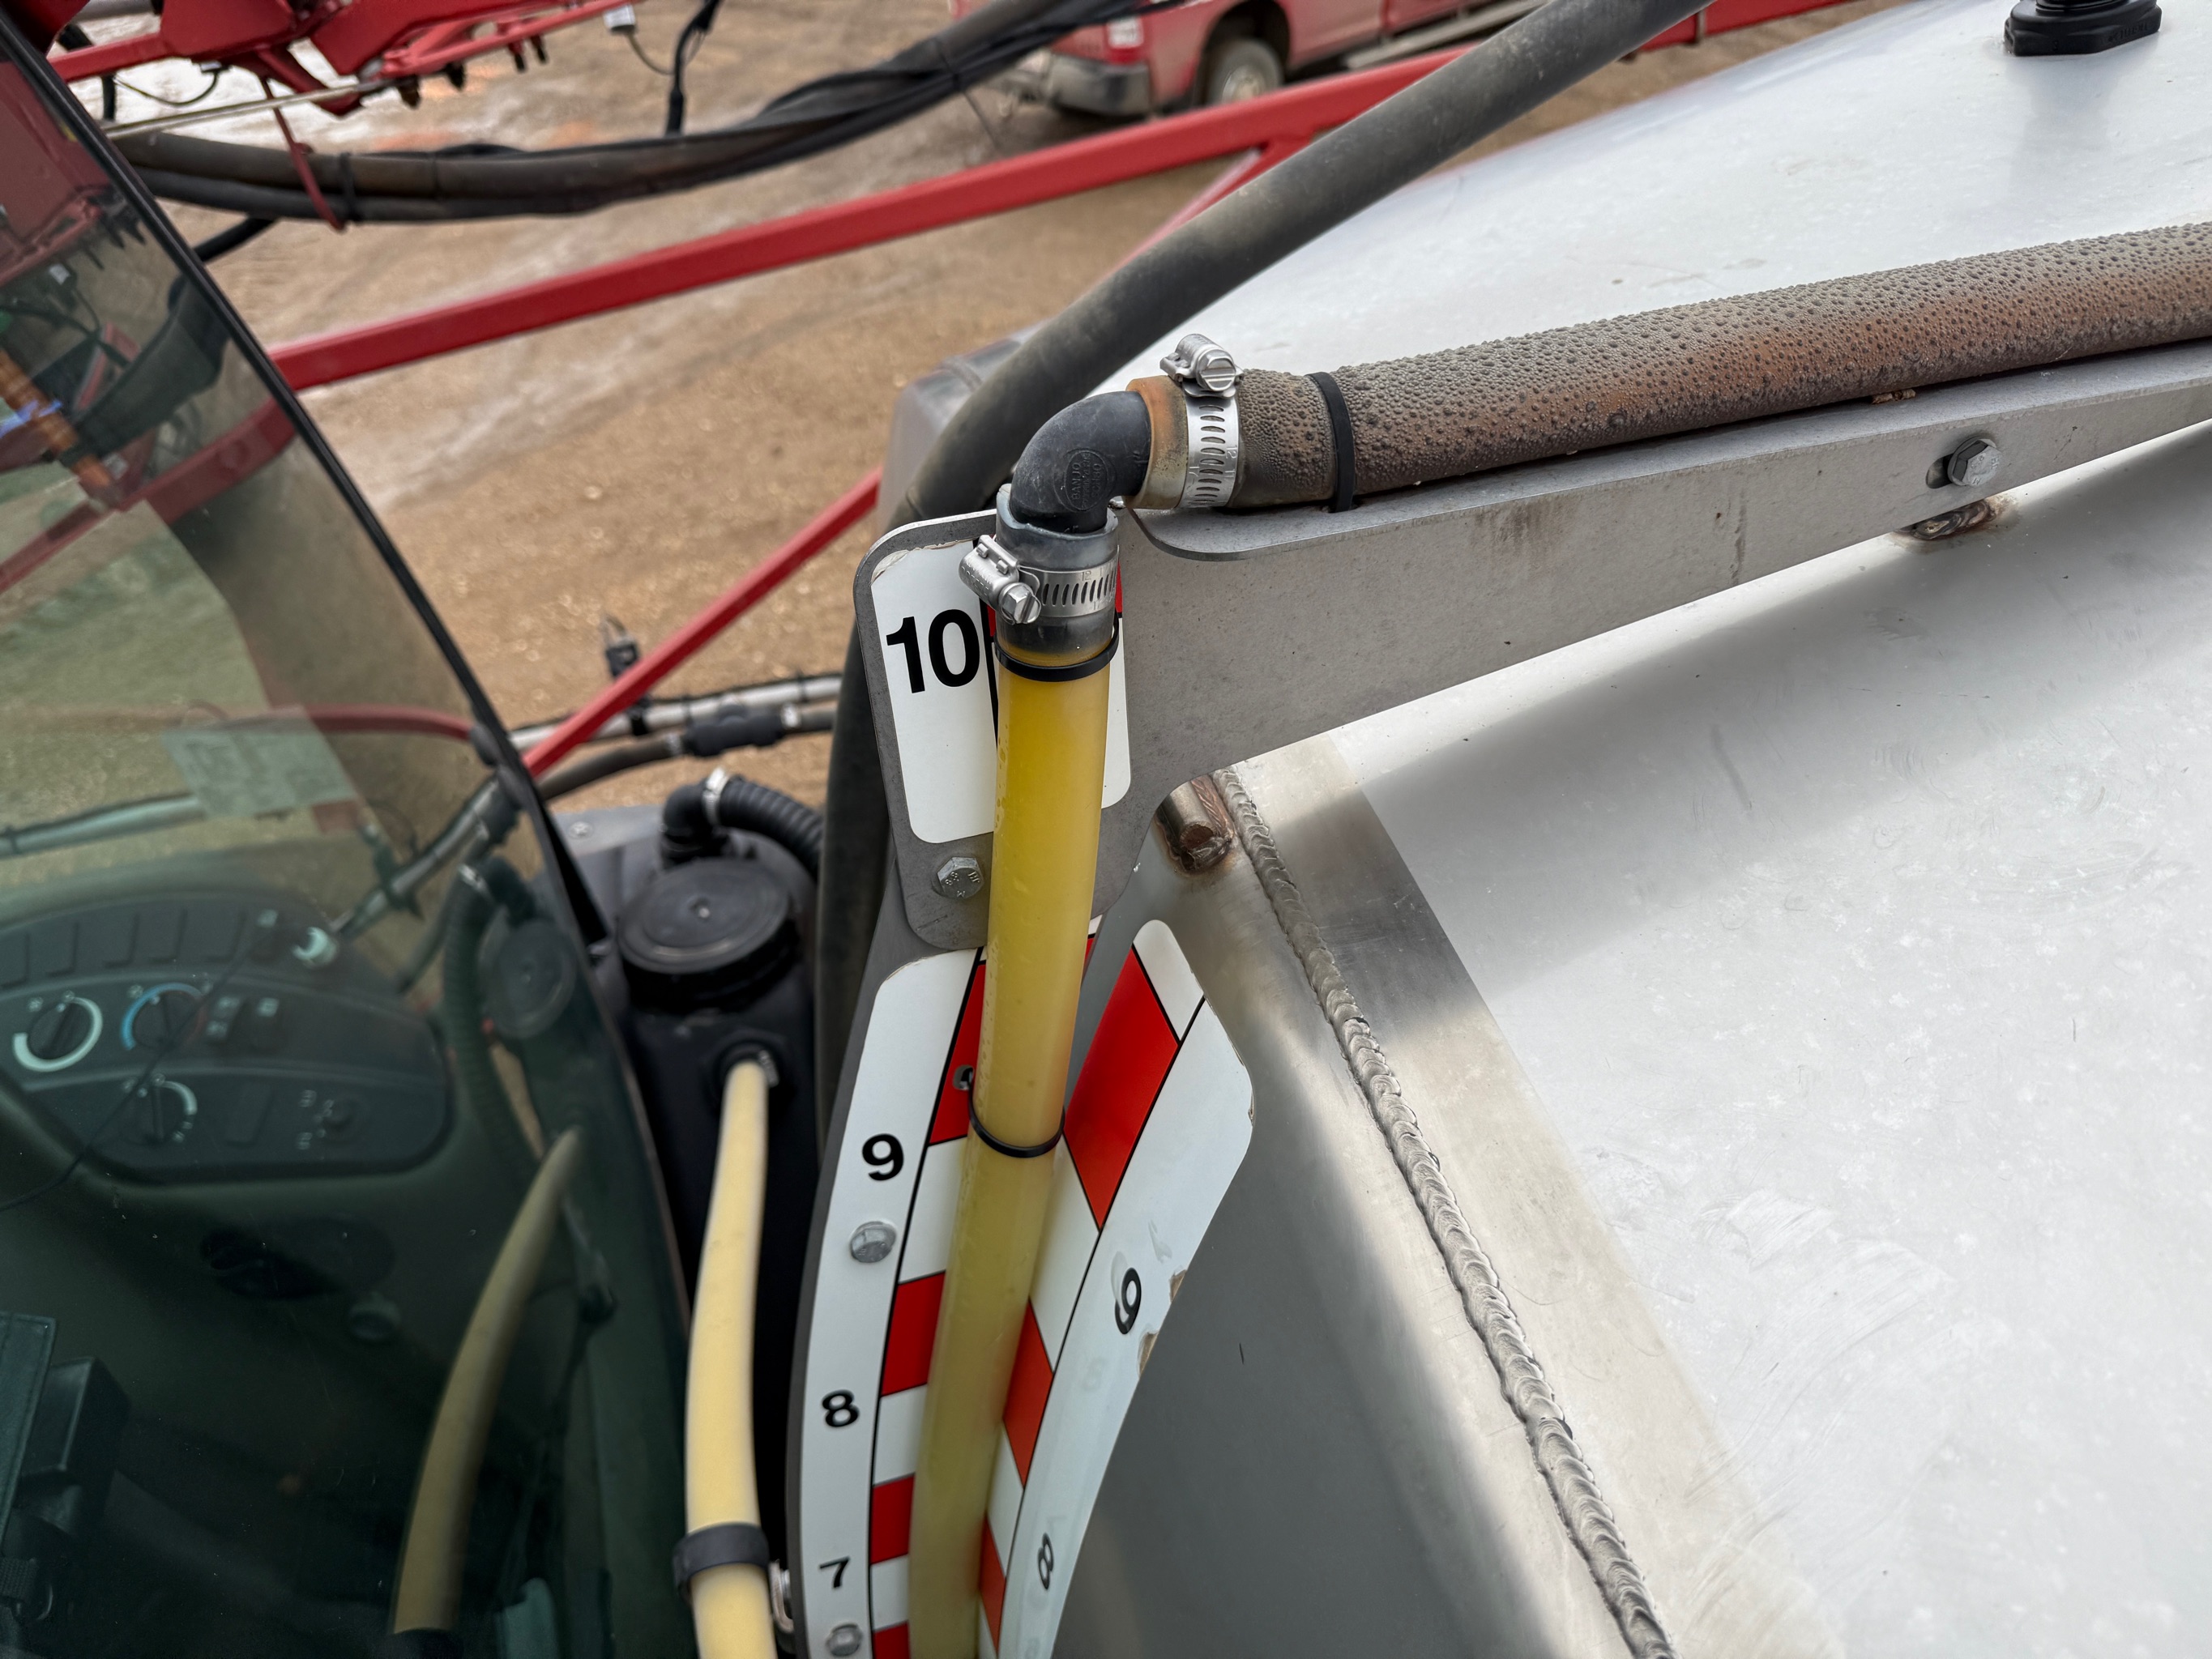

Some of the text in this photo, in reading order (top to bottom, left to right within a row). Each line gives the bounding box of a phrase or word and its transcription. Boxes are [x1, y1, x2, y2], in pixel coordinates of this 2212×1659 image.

[1071, 463, 1082, 500] BANJO
[886, 608, 980, 694] 10
[860, 1133, 905, 1181] 9
[821, 1389, 860, 1428] 8
[818, 1556, 853, 1590] 7
[1037, 1533, 1055, 1591] 8
